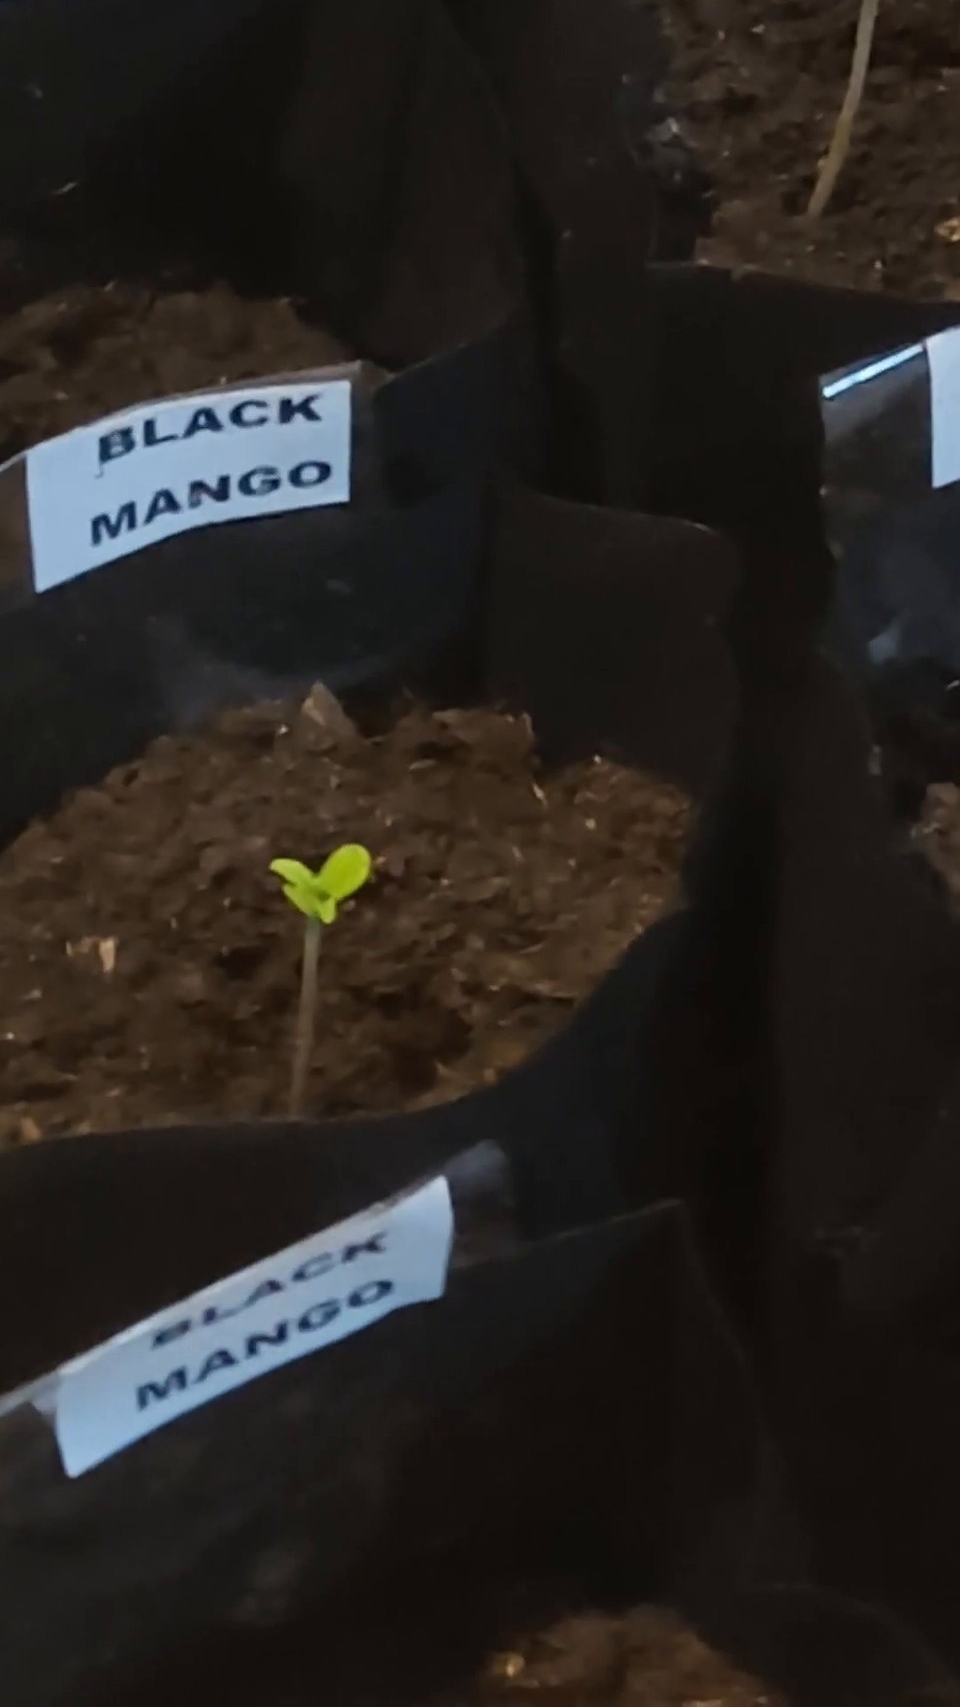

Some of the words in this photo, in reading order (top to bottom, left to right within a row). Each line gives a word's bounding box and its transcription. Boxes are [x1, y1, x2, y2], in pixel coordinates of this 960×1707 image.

[98, 393, 322, 466] BLACK
[90, 460, 332, 546] MANGO
[151, 1231, 389, 1349] BLACK
[134, 1278, 394, 1412] MANGO
